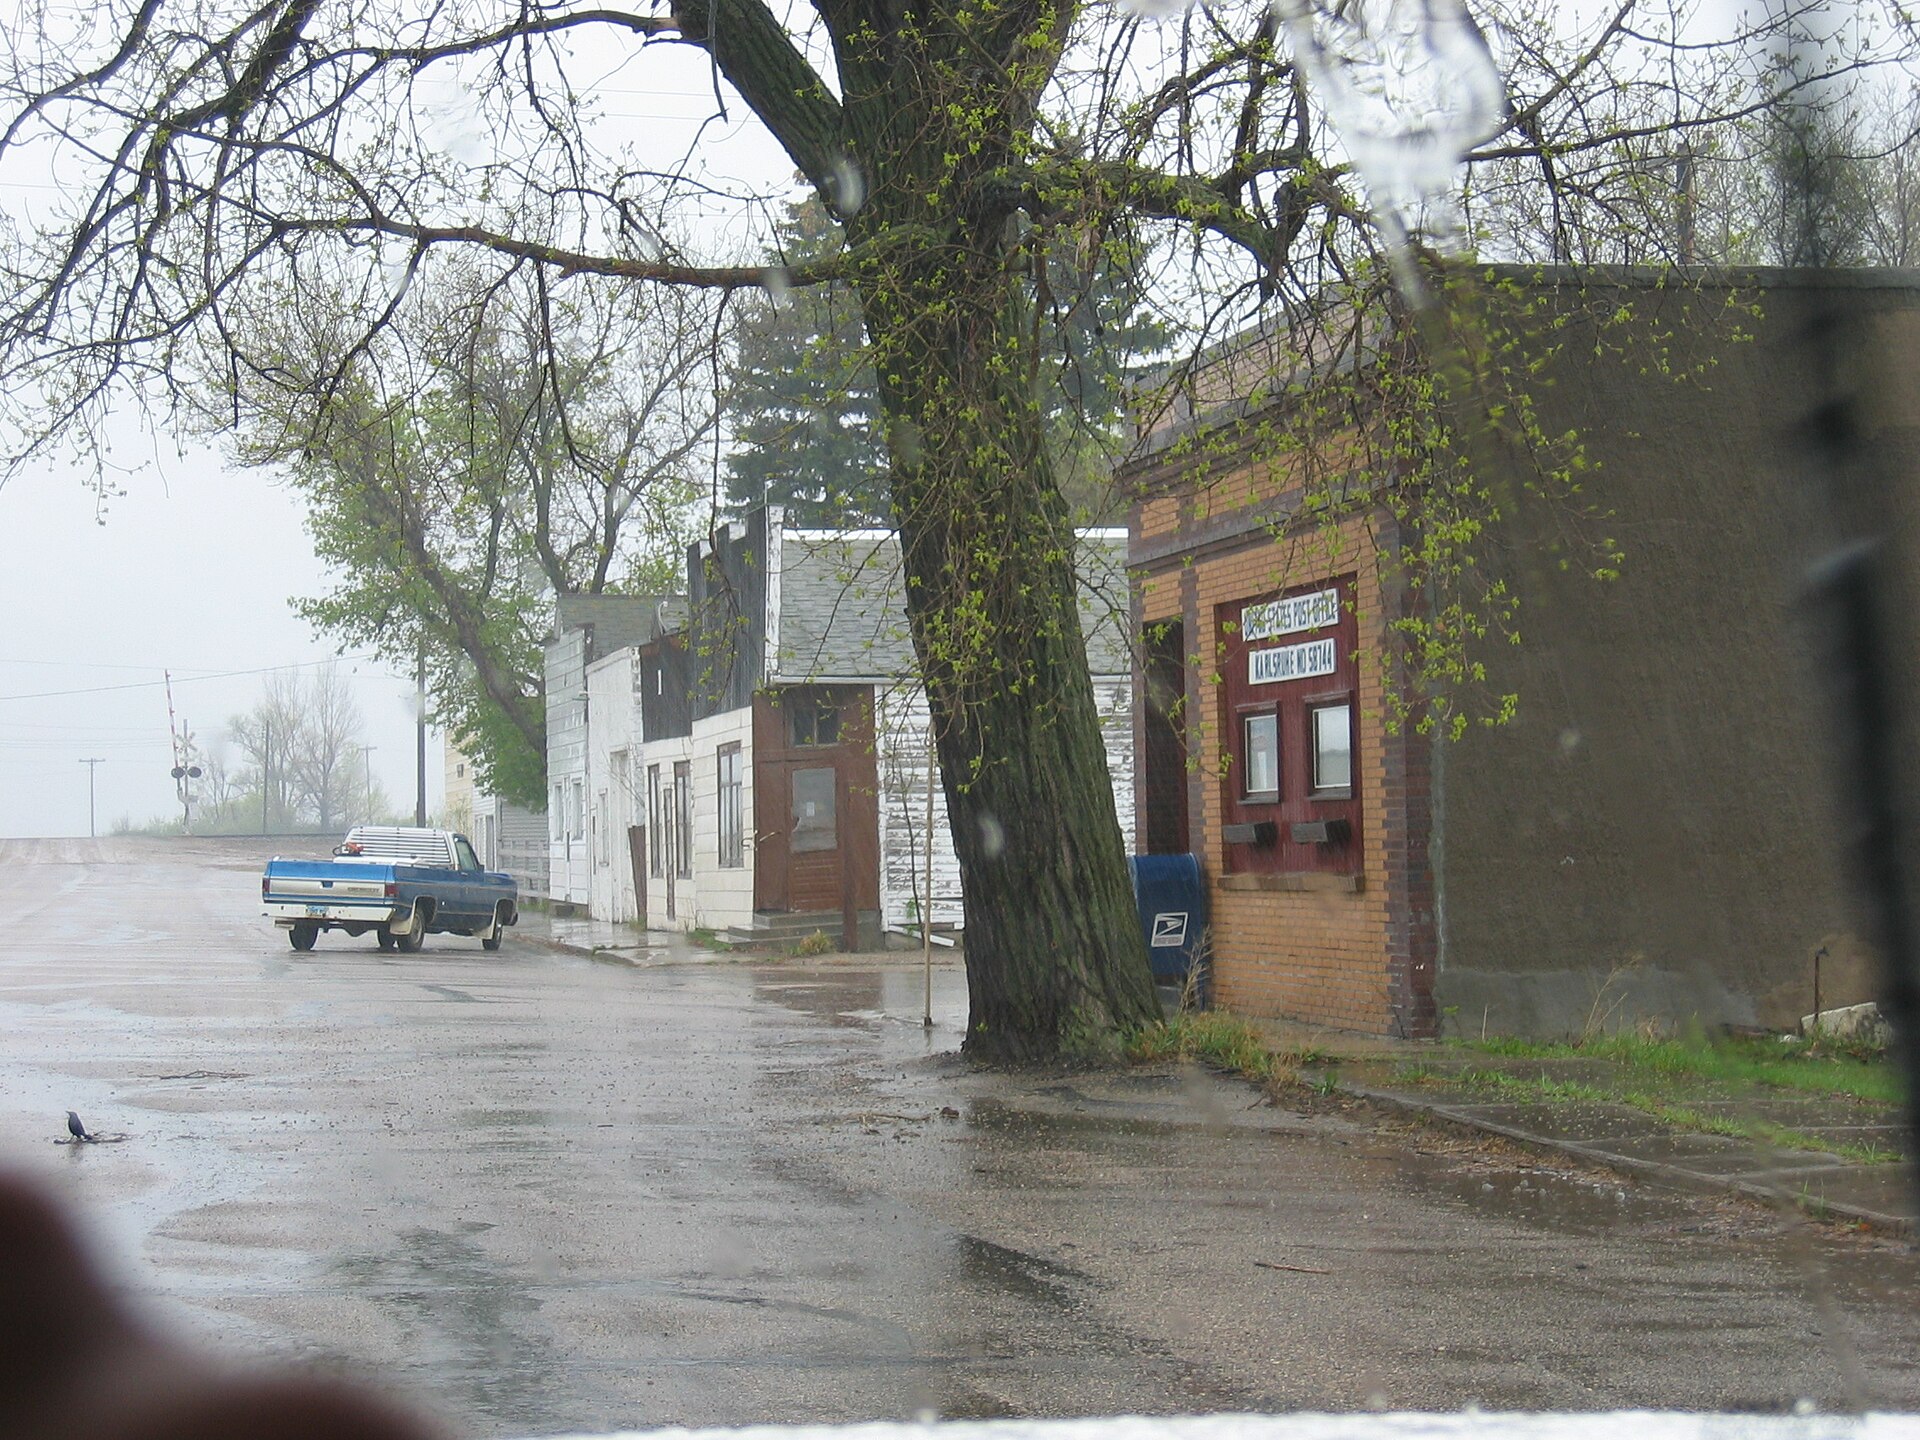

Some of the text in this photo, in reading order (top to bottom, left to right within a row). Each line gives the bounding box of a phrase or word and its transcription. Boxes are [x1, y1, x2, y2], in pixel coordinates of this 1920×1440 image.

[1294, 599, 1310, 626] POST
[1255, 642, 1332, 680] KARLSRUHE ND 58744
